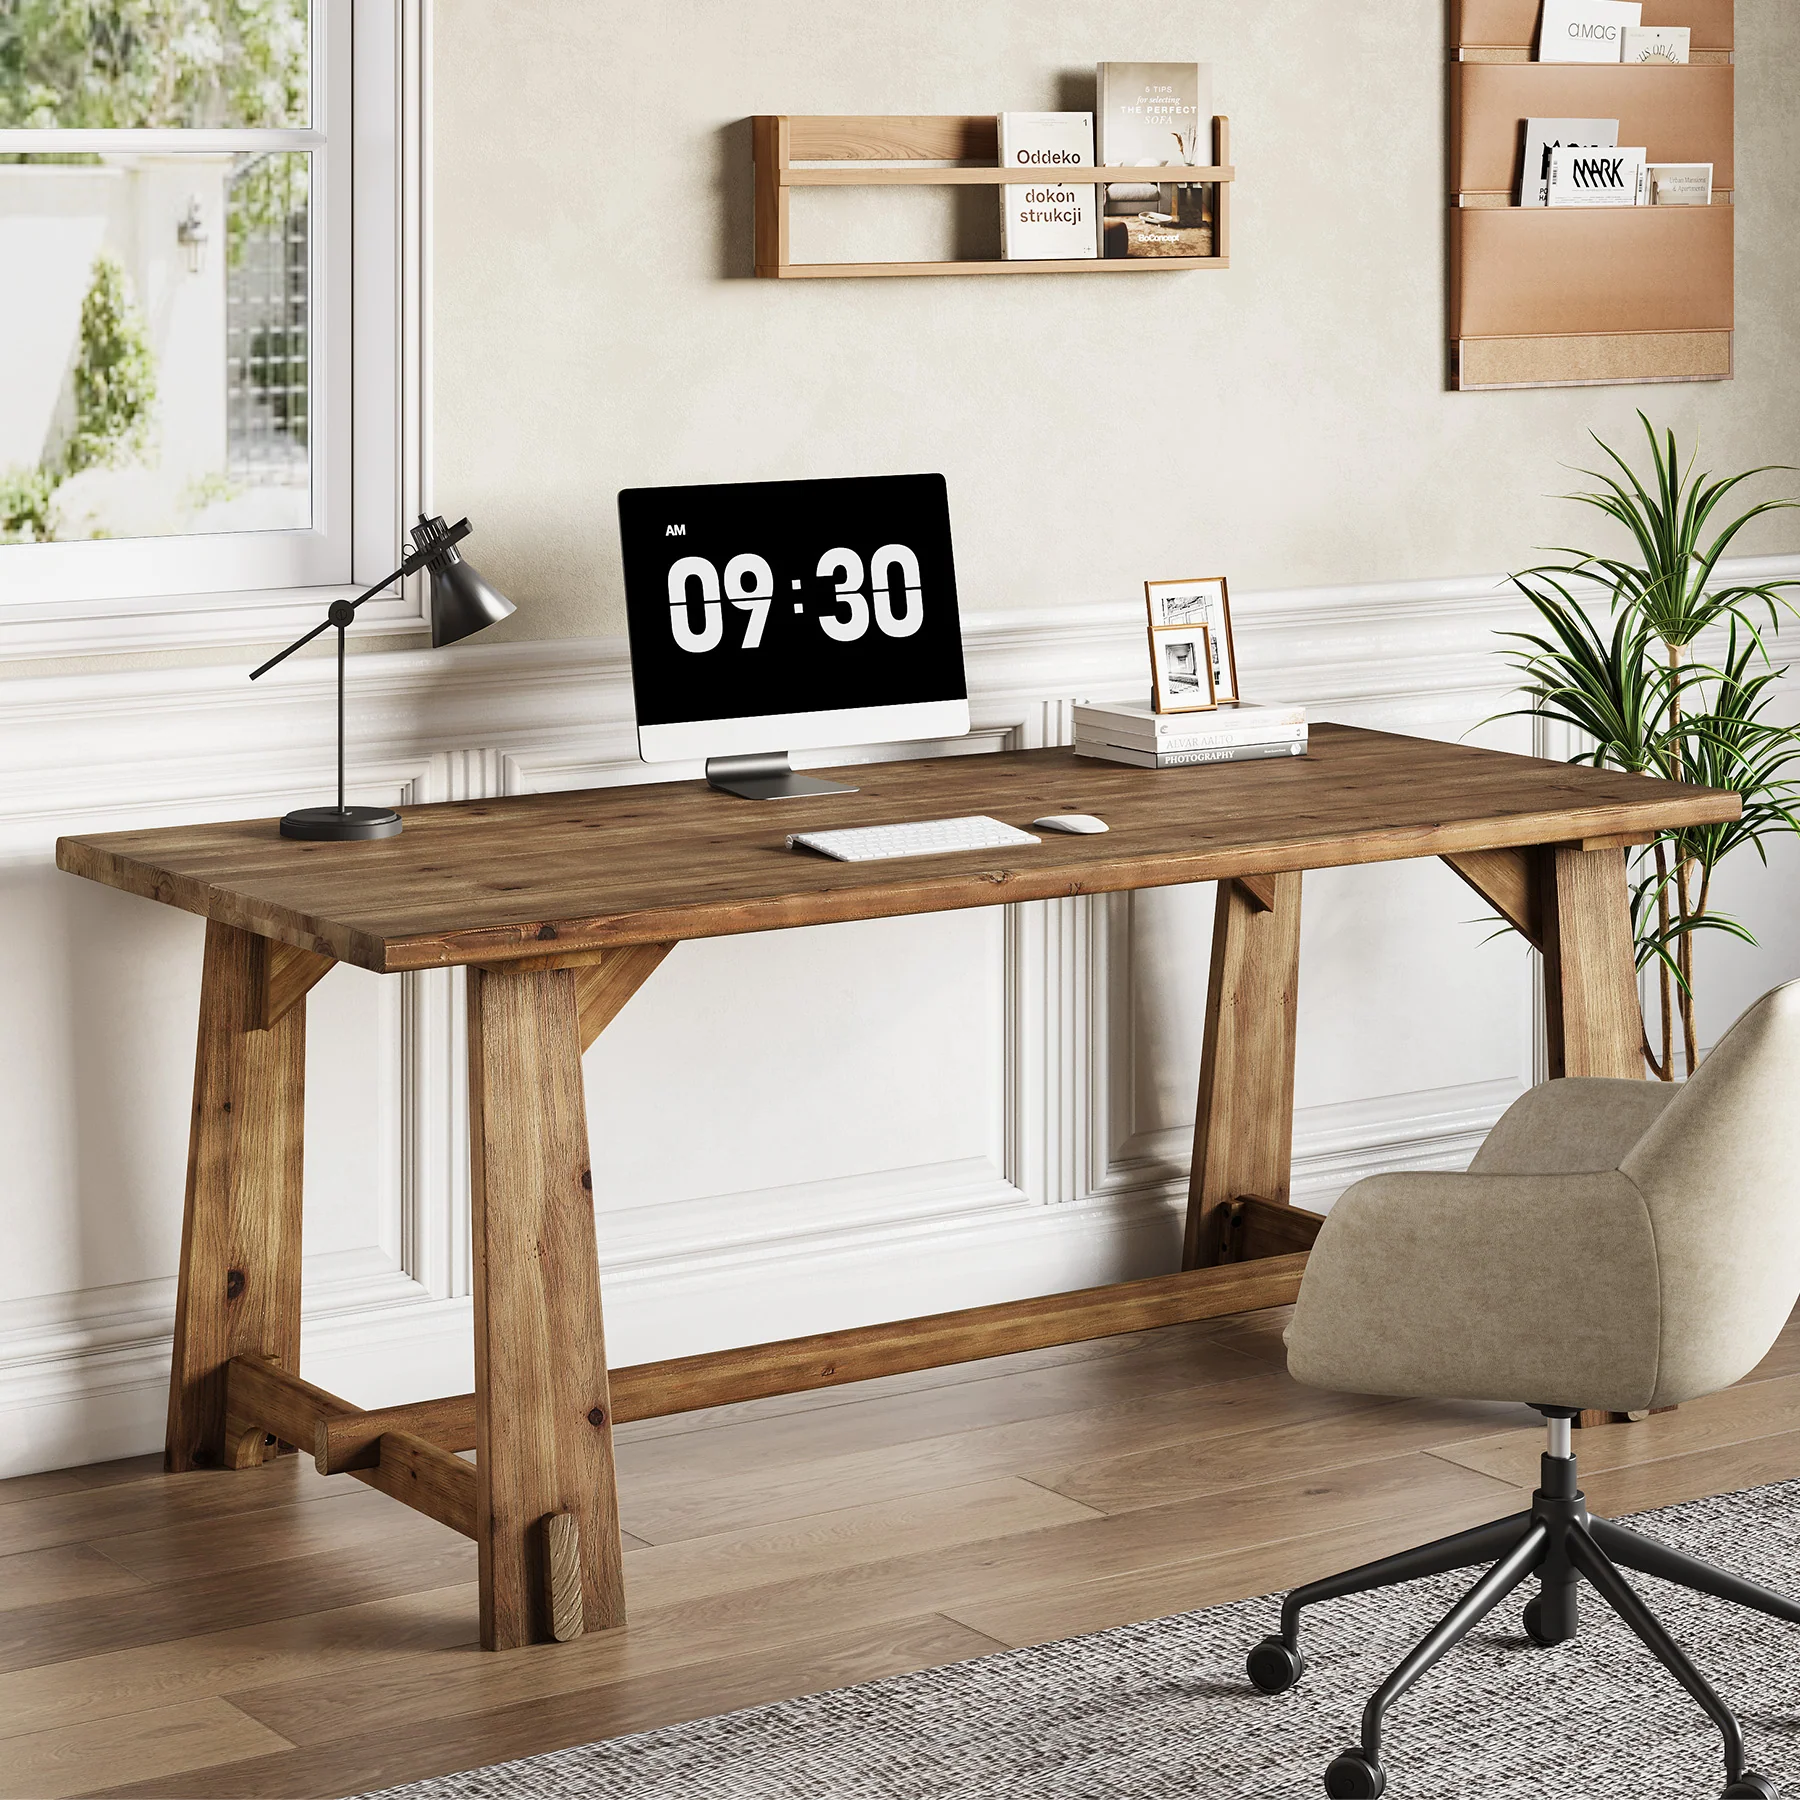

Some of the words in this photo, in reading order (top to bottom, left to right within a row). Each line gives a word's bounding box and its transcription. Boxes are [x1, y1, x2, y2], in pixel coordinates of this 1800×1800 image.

[1136, 96, 1148, 105] for
[1149, 96, 1180, 105] selecting
[1120, 106, 1142, 114] THE
[1147, 106, 1197, 114] PERFECT
[1144, 115, 1172, 124] SOFA
[1017, 149, 1081, 164] Oddeko
[1573, 158, 1624, 188] MARK
[1025, 189, 1075, 203] dokon
[1020, 208, 1081, 225] strukcji
[1138, 234, 1180, 243] BoConcept
[665, 524, 686, 537] AM
[1166, 737, 1199, 749] ALVAR
[1201, 735, 1234, 745] AALTO
[1165, 750, 1235, 764] PHOTOGRAPHY
